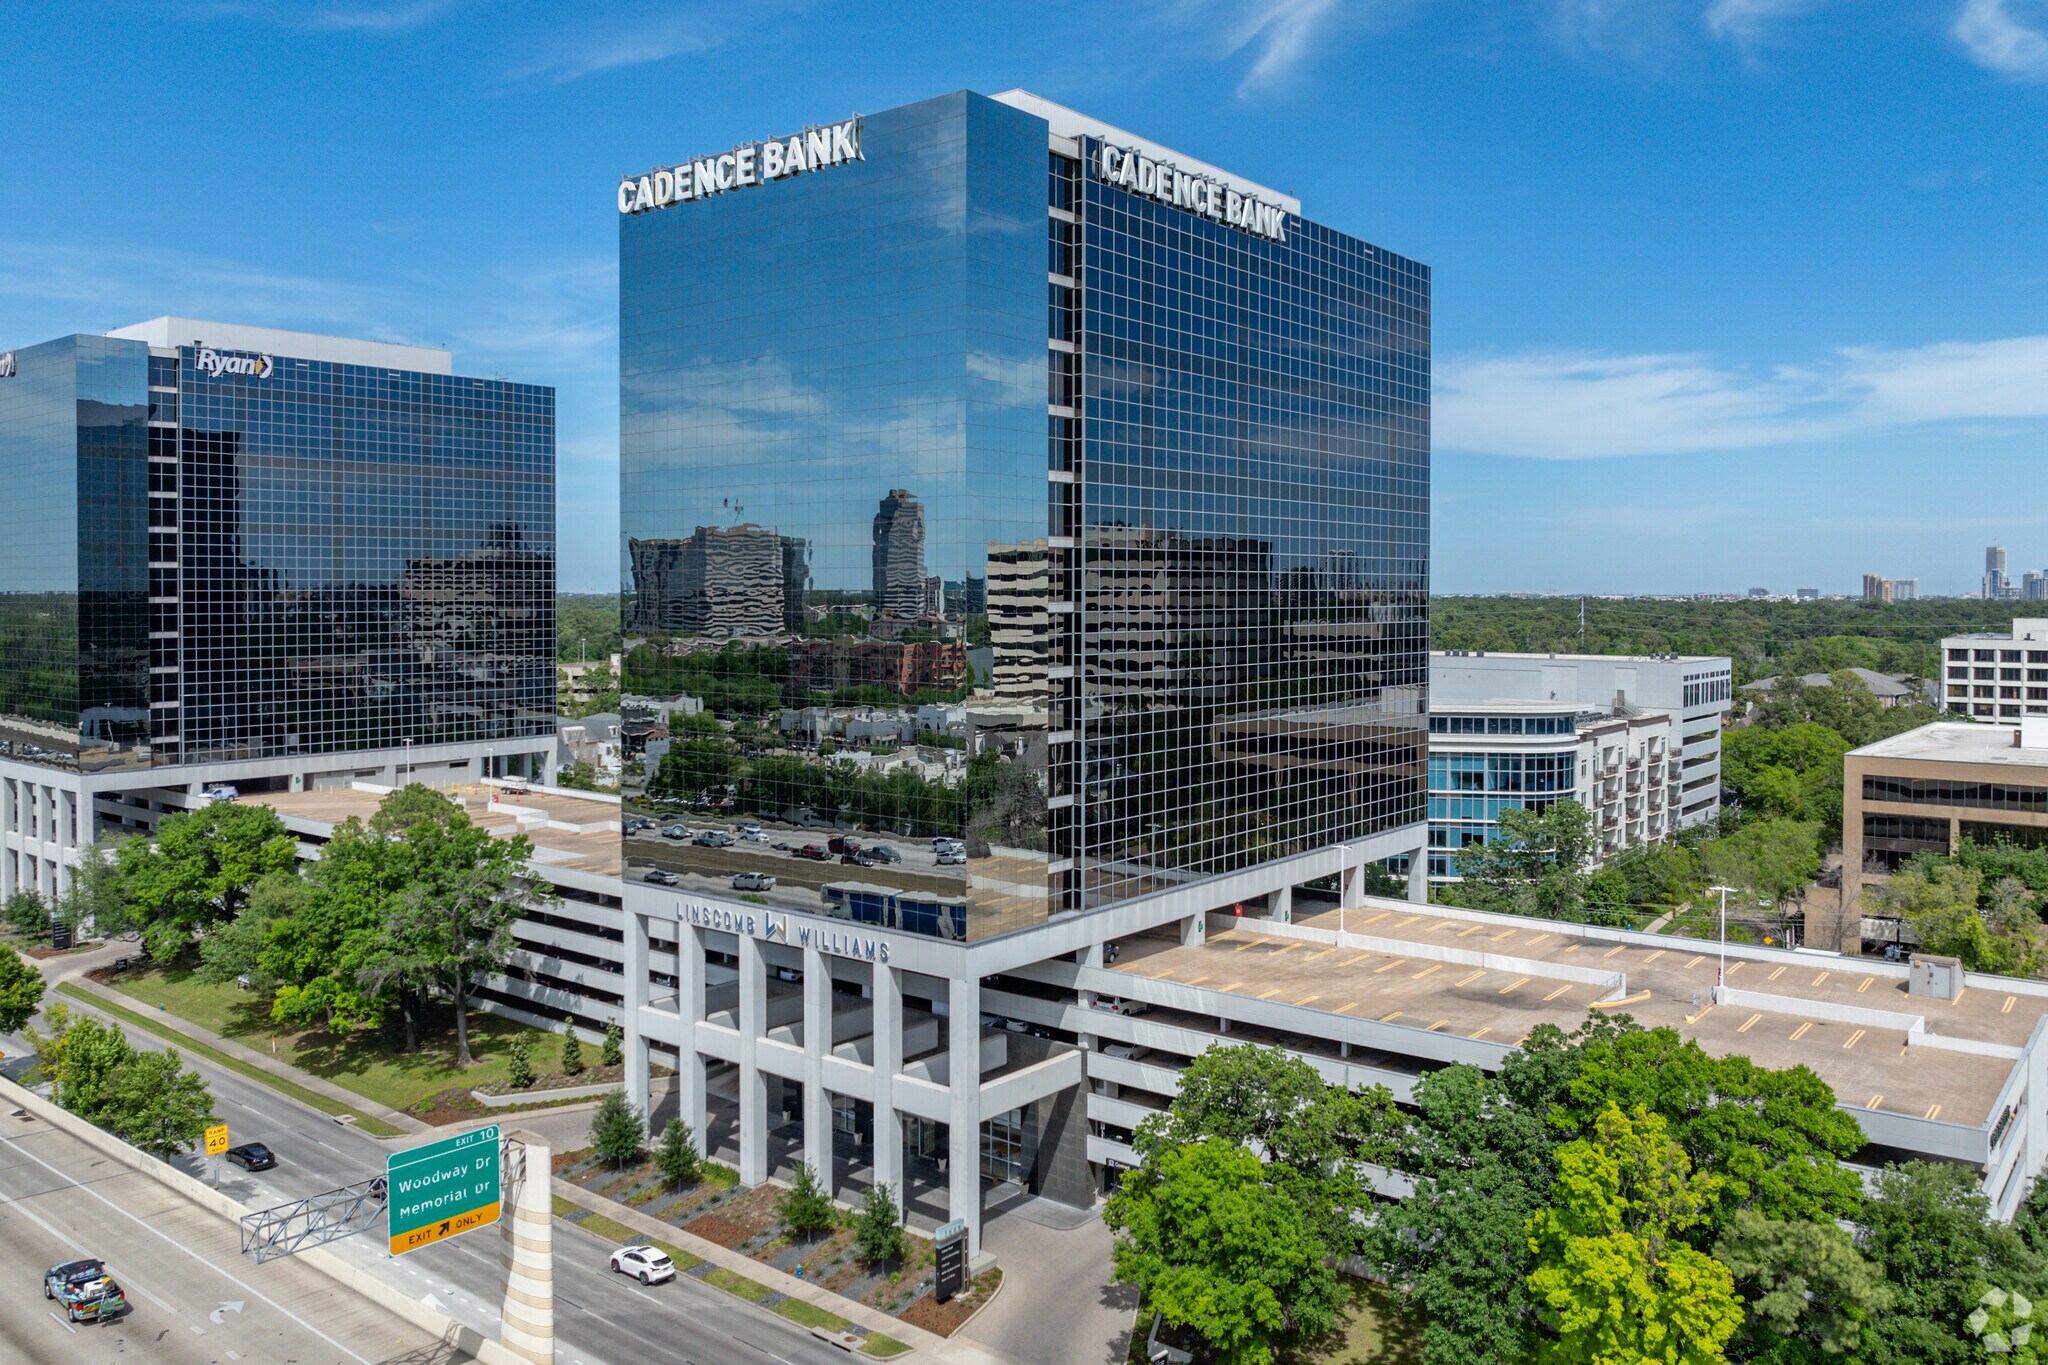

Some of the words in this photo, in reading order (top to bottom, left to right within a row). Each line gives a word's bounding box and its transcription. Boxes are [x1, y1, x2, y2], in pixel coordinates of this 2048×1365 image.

[617, 147, 756, 214] CADENCE
[763, 121, 857, 179] BANK
[1102, 146, 1225, 219] CADENCE
[1227, 185, 1287, 242] BANK
[197, 348, 256, 378] Ryan
[676, 901, 756, 934] LINSCOMB
[799, 925, 890, 962] WILLIAMS
[208, 1127, 226, 1135] RAMP
[209, 1136, 226, 1147] 40
[455, 1134, 475, 1147] EXIT
[480, 1127, 495, 1140] 10
[398, 1164, 468, 1194] Woodway
[475, 1156, 491, 1170] Dr
[400, 1188, 468, 1219] Memorial
[474, 1181, 490, 1195] Dr
[408, 1229, 432, 1245] EXIT
[456, 1212, 483, 1229] ONLY
